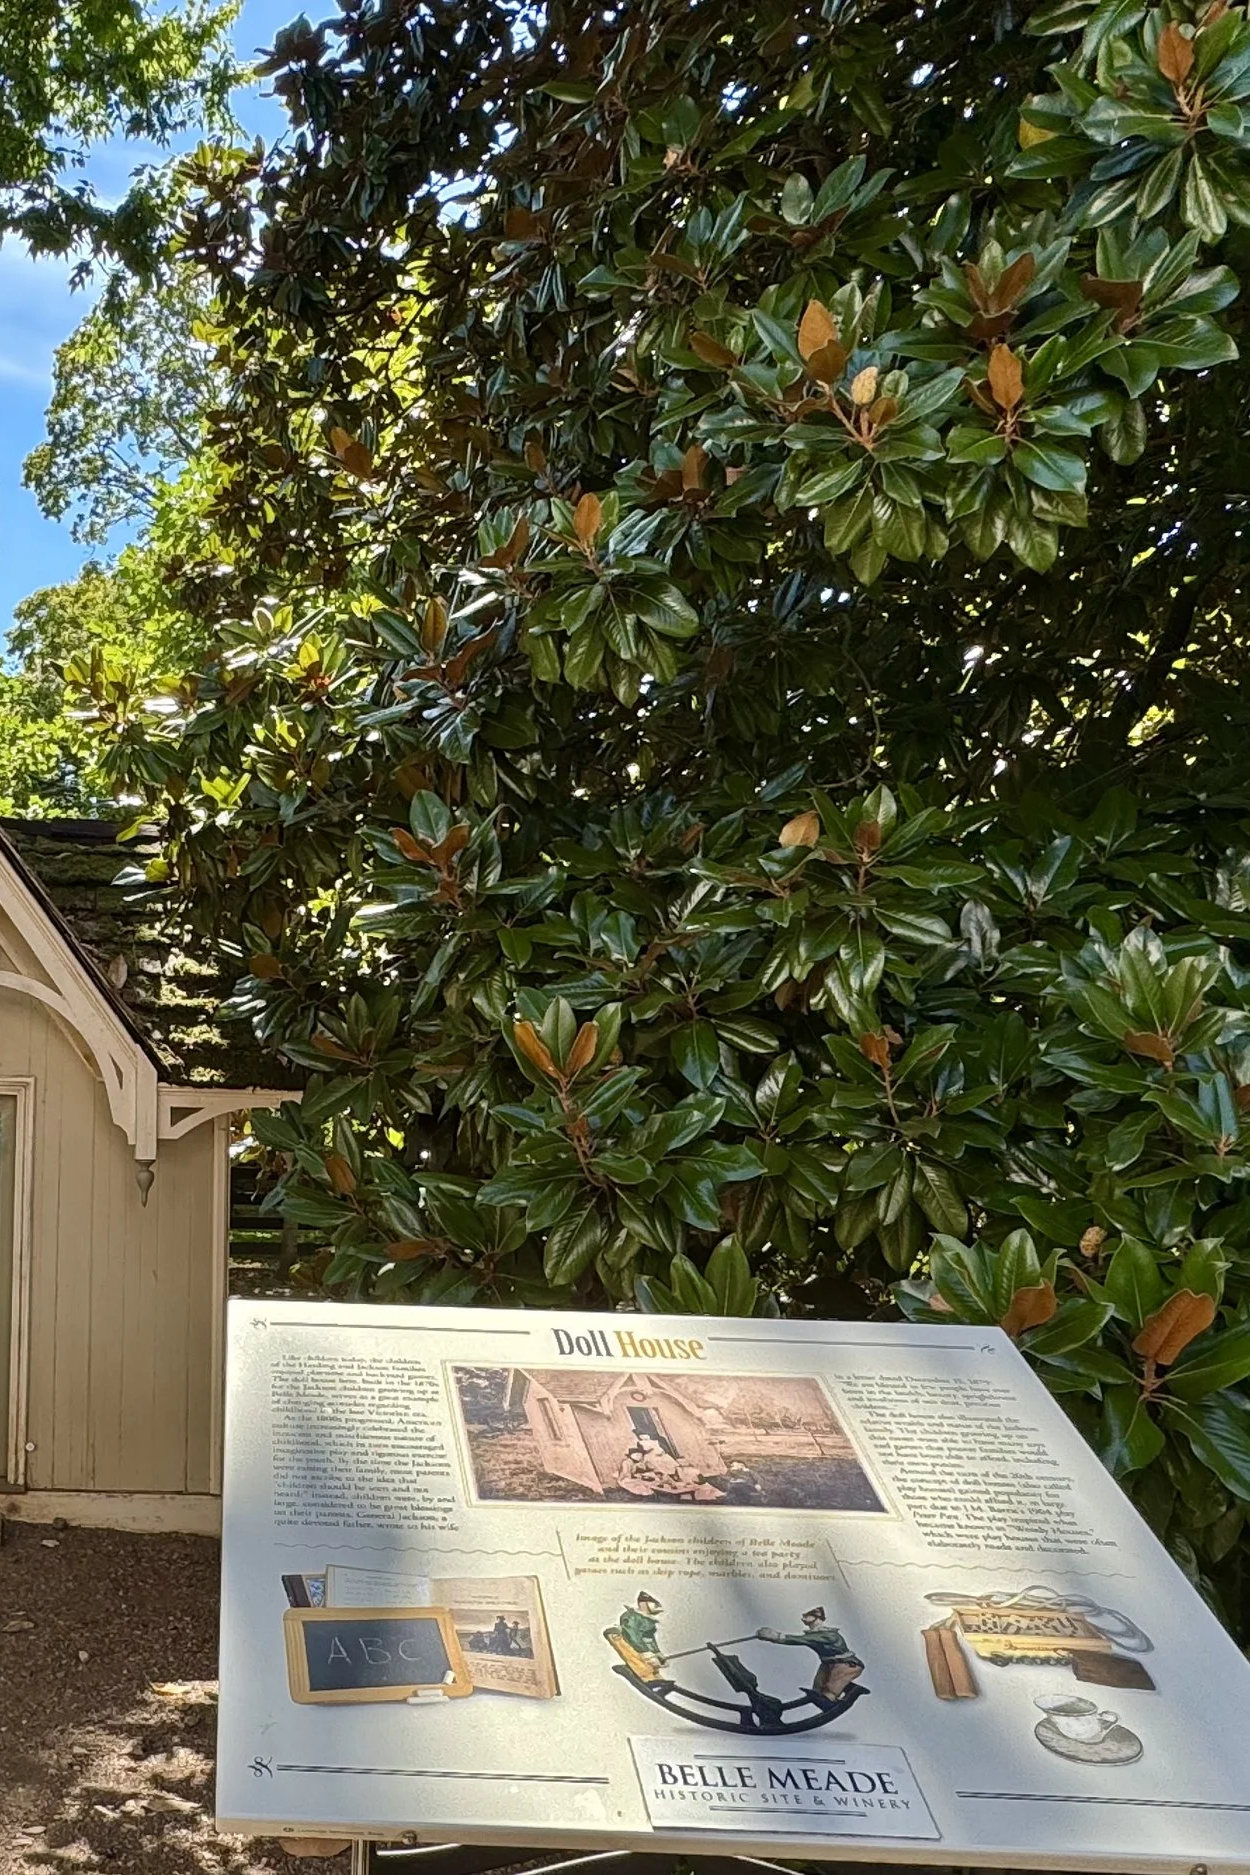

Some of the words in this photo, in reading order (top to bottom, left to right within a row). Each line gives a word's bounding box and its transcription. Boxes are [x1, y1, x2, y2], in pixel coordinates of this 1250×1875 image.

[552, 1327, 614, 1358] Doll
[614, 1330, 706, 1361] House
[327, 1636, 352, 1665] A
[359, 1637, 392, 1665] B
[398, 1638, 425, 1661] C
[655, 1763, 757, 1788] BELLE
[767, 1767, 899, 1795] MEADE
[654, 1789, 749, 1803] HISTORIC
[761, 1793, 802, 1805] SITE
[813, 1795, 825, 1806] &
[833, 1796, 911, 1810] WINERY
